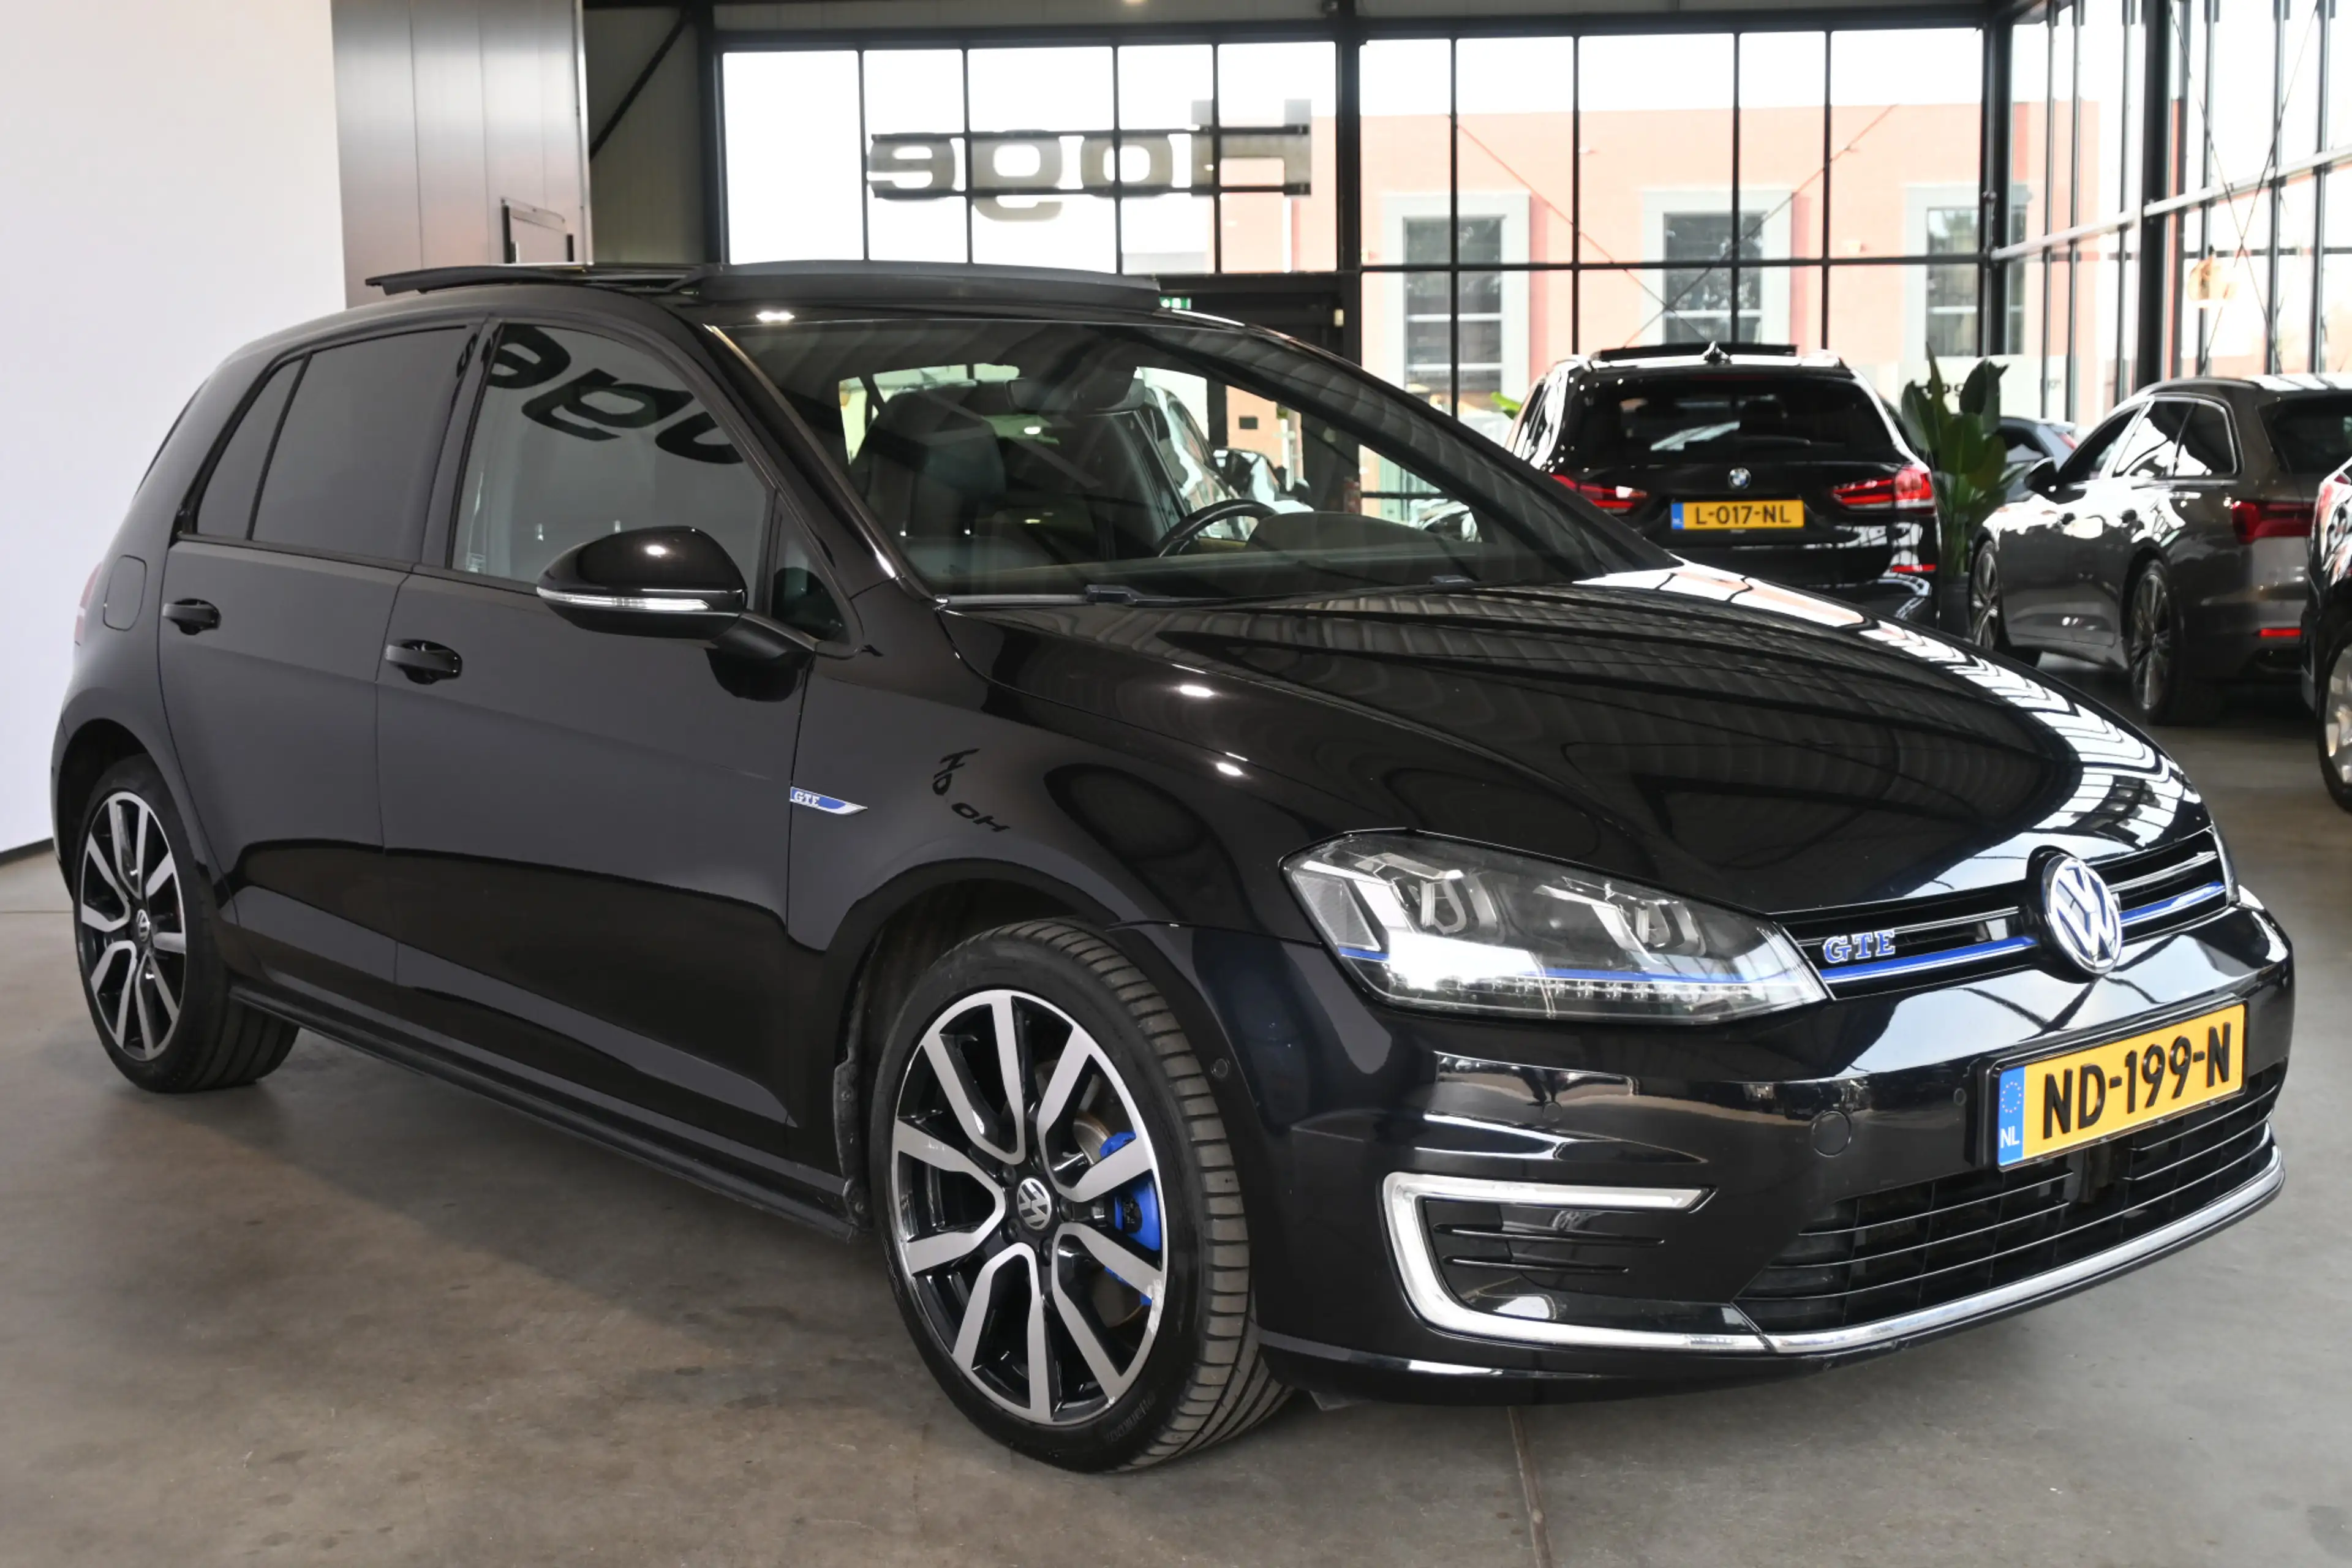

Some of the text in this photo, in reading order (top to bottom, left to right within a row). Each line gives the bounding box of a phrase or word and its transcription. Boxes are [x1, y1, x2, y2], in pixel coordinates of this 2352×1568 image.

[1695, 505, 1792, 524] L-017-NL
[794, 791, 820, 808] GTE
[1823, 929, 1896, 963] GTE
[2042, 1022, 2231, 1139] ND-199-N
[2000, 1126, 2020, 1148] NL
